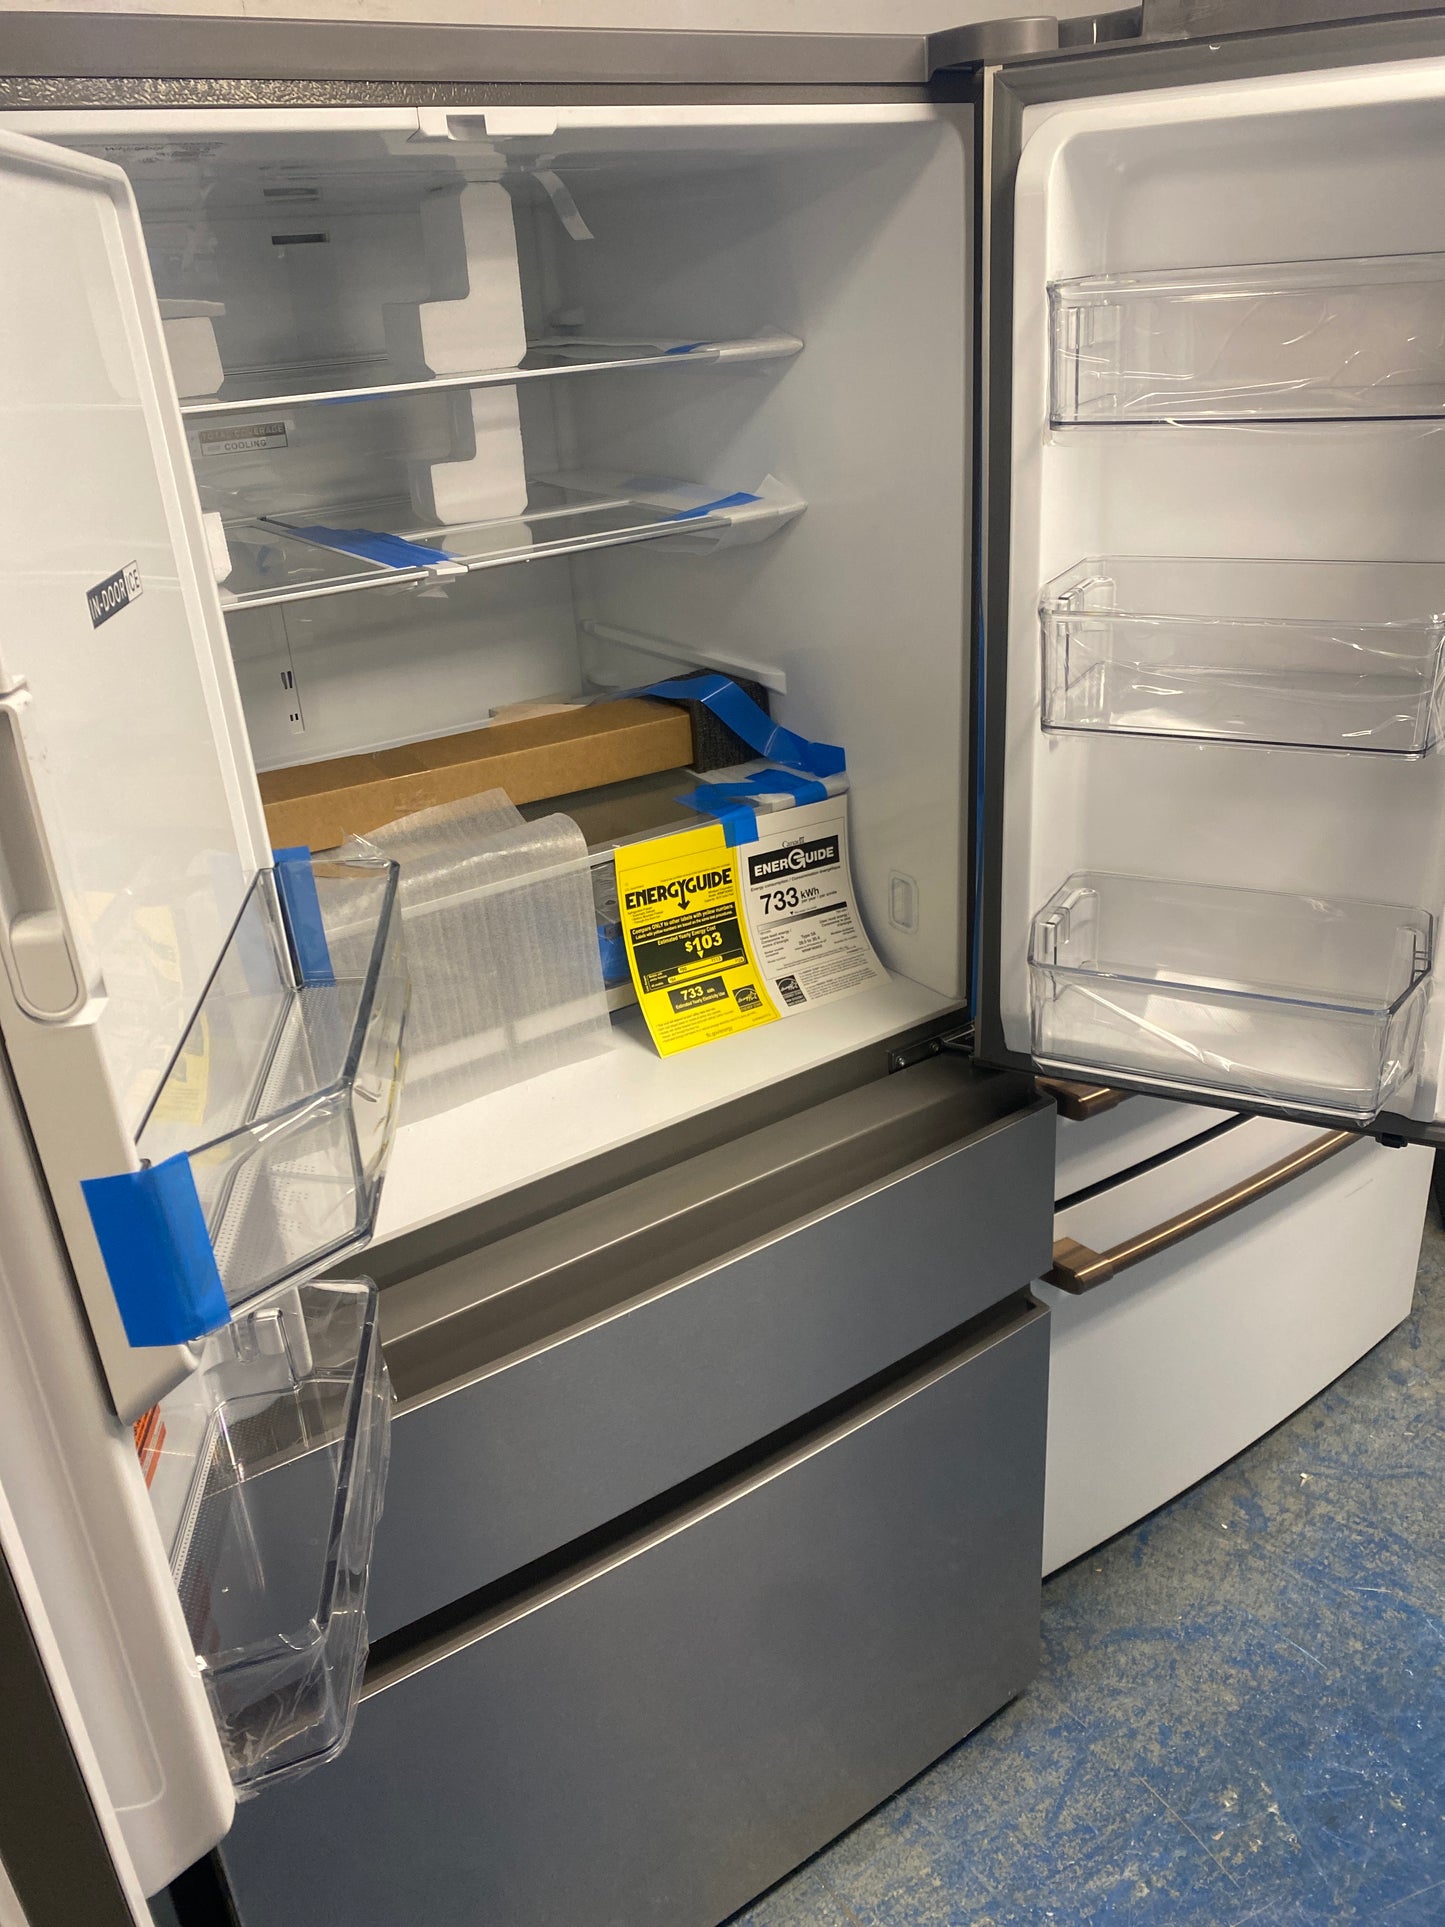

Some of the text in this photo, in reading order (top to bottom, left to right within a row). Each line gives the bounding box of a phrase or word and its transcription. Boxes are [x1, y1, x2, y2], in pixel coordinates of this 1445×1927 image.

[224, 439, 266, 451] COOLING
[88, 569, 140, 620] IN-DOOR ICE
[624, 868, 732, 910] ENERGYGUIDE
[760, 886, 820, 914] 733 kWh
[685, 932, 723, 953] $103
[680, 986, 704, 1001] 733
